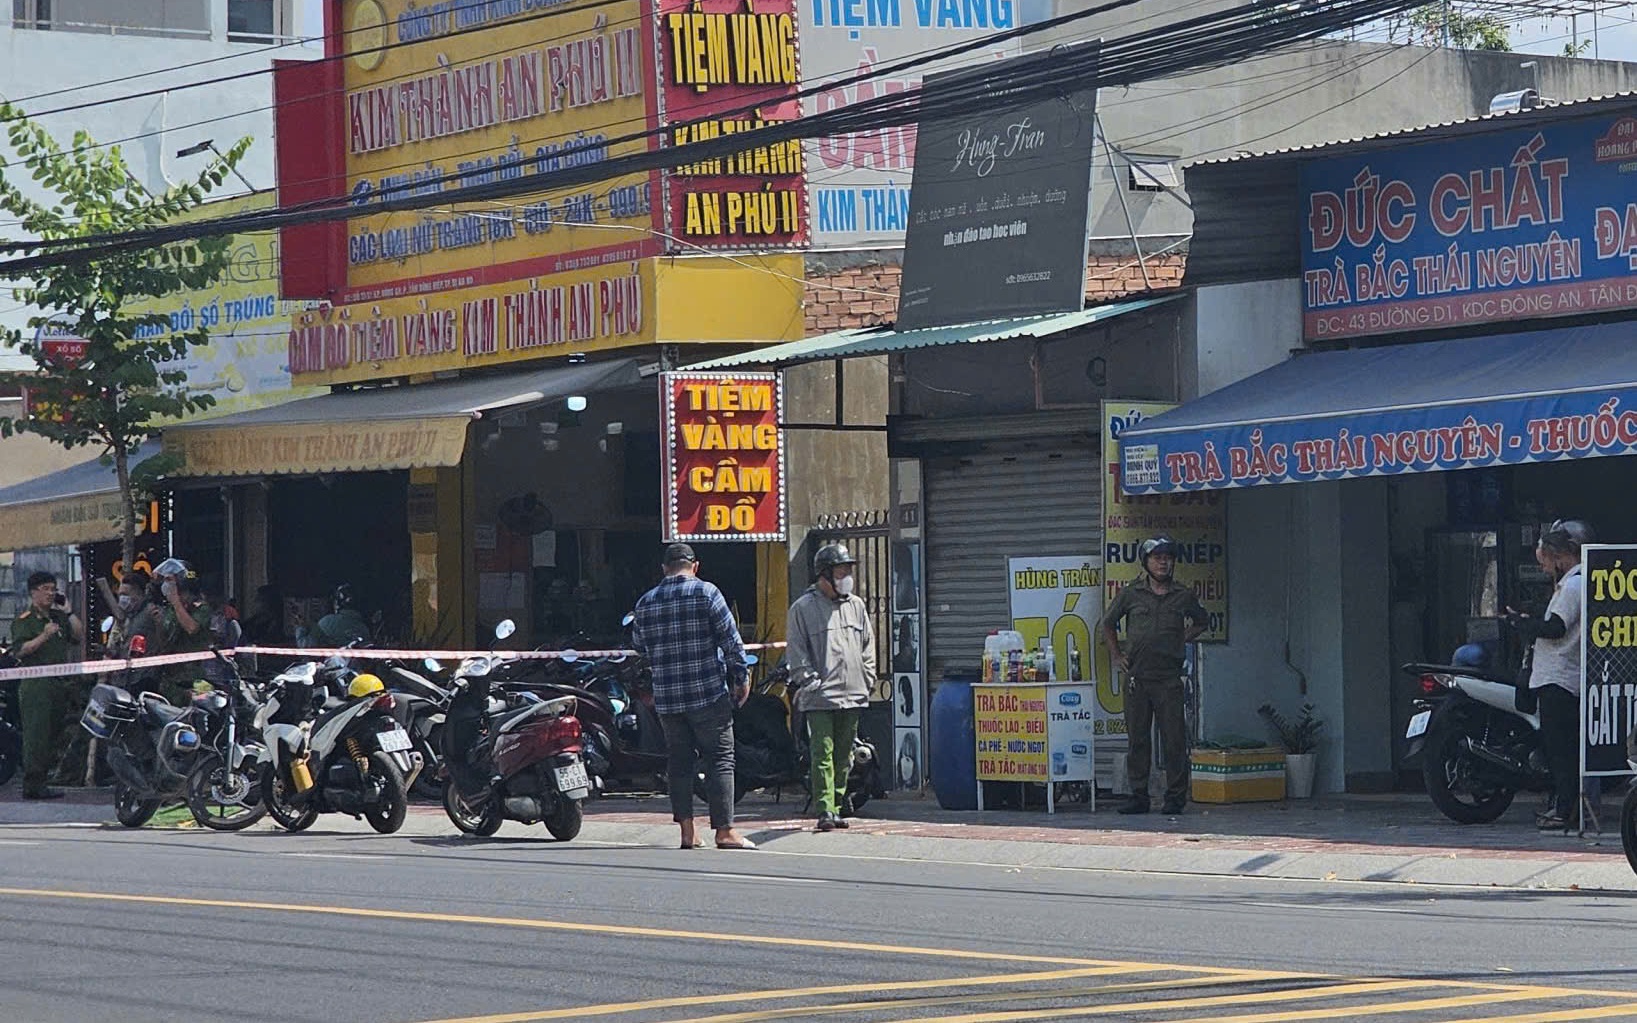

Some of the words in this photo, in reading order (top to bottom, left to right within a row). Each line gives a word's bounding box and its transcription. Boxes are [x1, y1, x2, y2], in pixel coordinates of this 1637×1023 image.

[669, 0, 730, 92] TIỆM
[732, 0, 796, 84] VÀNG
[350, 85, 400, 154] KIM
[401, 54, 497, 143] THÀNH
[500, 52, 545, 122] AN
[547, 13, 612, 112] PHÚ
[613, 28, 642, 98] II
[686, 192, 720, 235] AN
[727, 182, 776, 235] PHÚ
[781, 190, 798, 232] II
[817, 189, 857, 232] KIM
[861, 179, 911, 231] THÀN
[1309, 165, 1417, 253] ĐỨC
[1430, 132, 1569, 237] CHẤT
[350, 226, 377, 264] CÁC
[563, 193, 596, 225] 24K
[1009, 219, 1027, 236] viên
[1305, 255, 1351, 307] TRÀ
[1356, 243, 1409, 302] BẮC
[1413, 241, 1470, 295] THÁI
[1477, 230, 1582, 289] NGUYÊN
[200, 295, 220, 327] SỐ
[224, 293, 275, 323] TRÚNG
[403, 299, 457, 356] VÀNG
[463, 298, 498, 356] KIM
[504, 277, 566, 350] THÀNH
[569, 282, 594, 341] AN
[600, 261, 641, 337] PHÚ
[1317, 316, 1345, 335] ĐC:
[1348, 314, 1366, 330] 43
[1369, 306, 1430, 328] ĐƯỜNG
[1462, 300, 1497, 318] KDC
[1500, 294, 1552, 314] ĐÔNG
[1589, 284, 1622, 304] TÂN
[684, 378, 772, 418] TIỆM
[681, 415, 778, 450] VÀNG
[1110, 409, 1152, 440] ĐỨ
[1165, 441, 1225, 484] TRÀ
[1229, 428, 1288, 480] BẮC
[1293, 428, 1366, 474] THÁI
[1371, 414, 1504, 467] NGUYÊN
[1527, 396, 1637, 454] THUỐC
[689, 456, 772, 492] CẦM
[705, 495, 756, 531] ĐỒ
[1015, 567, 1058, 589] HÙNG
[977, 691, 995, 712] TRÀ
[998, 689, 1018, 712] BẮC
[1050, 710, 1070, 721] TRÀ
[978, 716, 1003, 733] THUỐC
[978, 756, 996, 775] TRÀ
[998, 754, 1016, 775] TẮC
